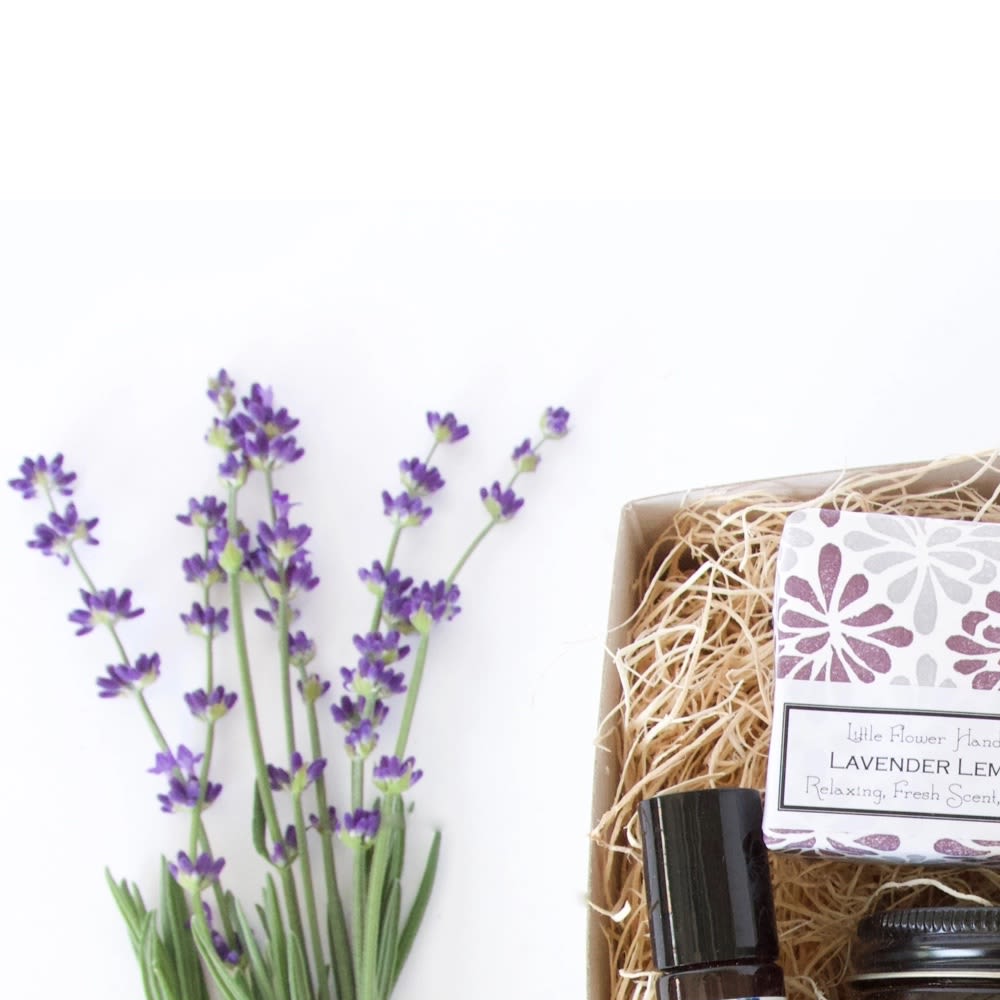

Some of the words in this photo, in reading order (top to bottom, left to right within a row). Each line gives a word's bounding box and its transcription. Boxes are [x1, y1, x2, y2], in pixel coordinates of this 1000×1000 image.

[847, 722, 883, 745] Little
[889, 724, 947, 746] Flower
[805, 776, 886, 804] Relaxing,
[892, 780, 940, 802] Fresh
[945, 785, 1000, 808] Scent,
